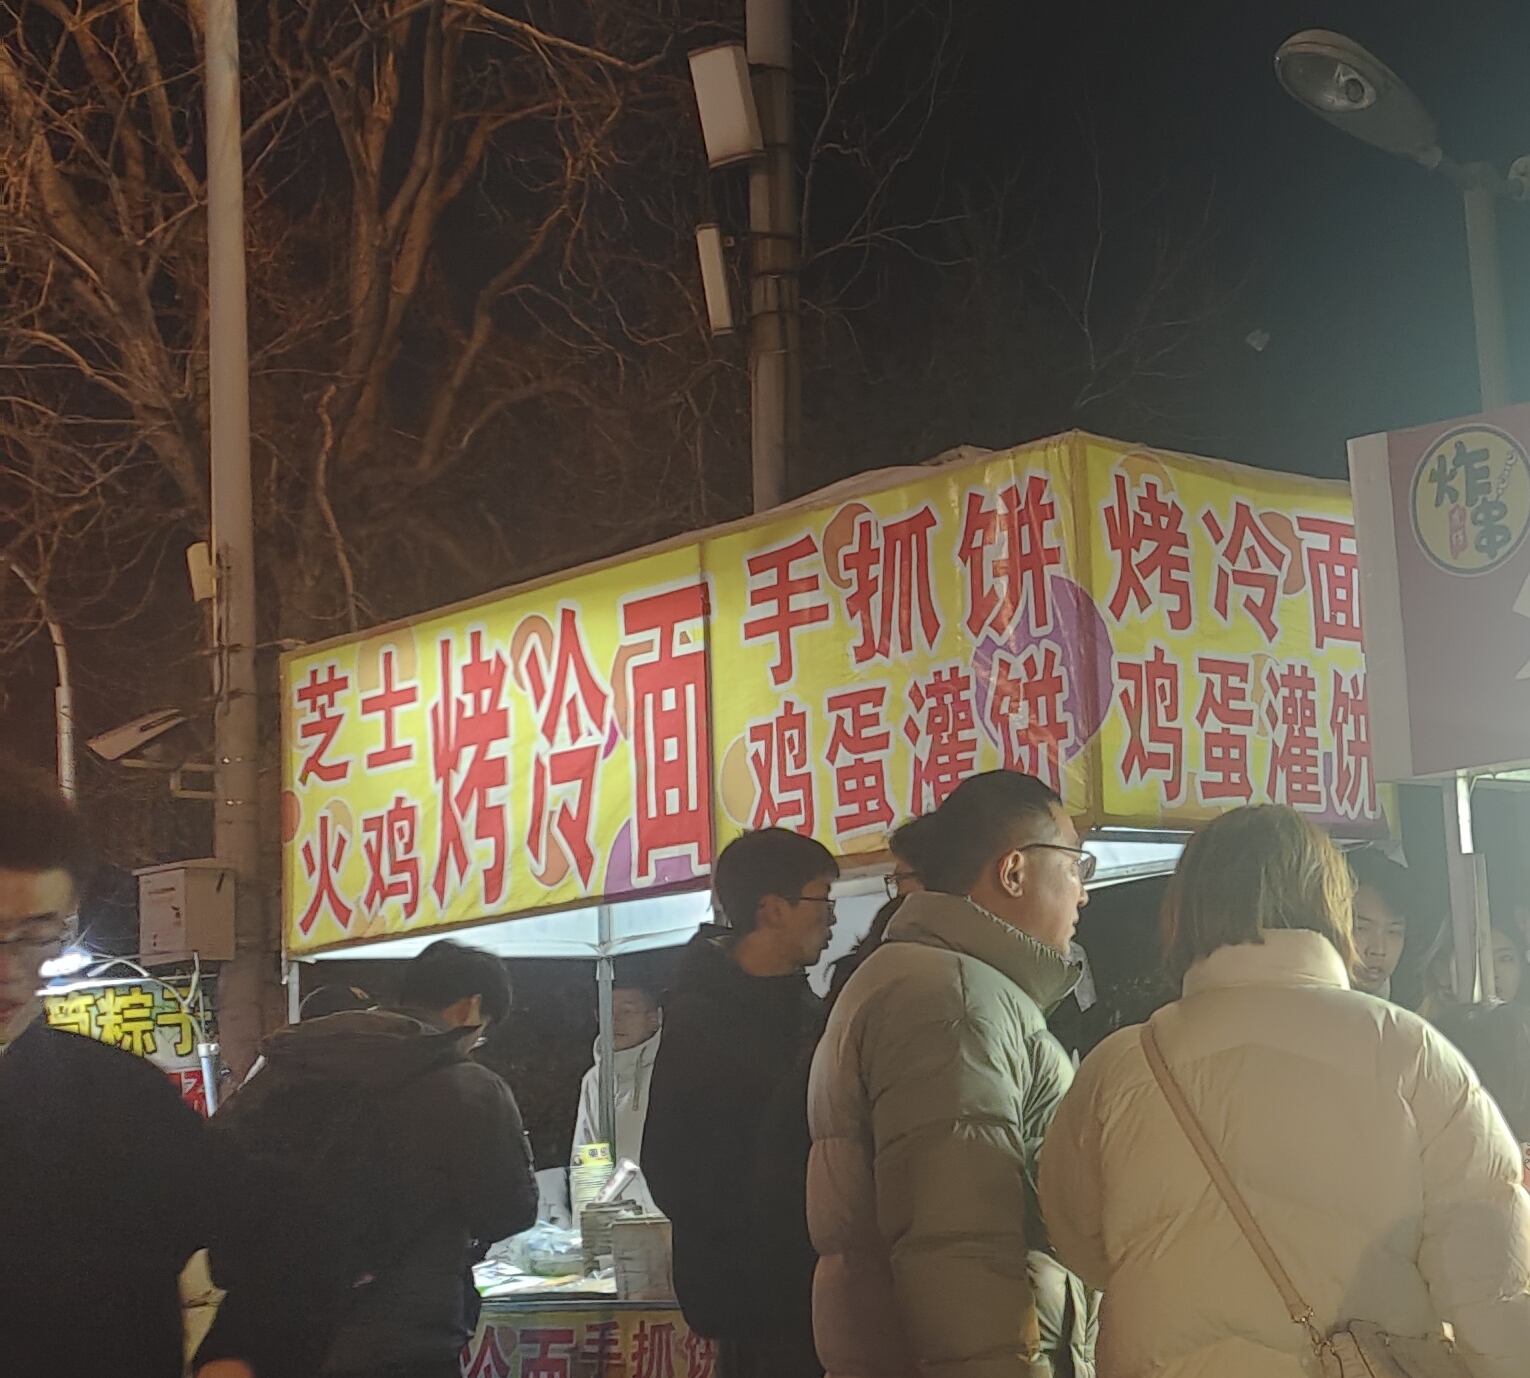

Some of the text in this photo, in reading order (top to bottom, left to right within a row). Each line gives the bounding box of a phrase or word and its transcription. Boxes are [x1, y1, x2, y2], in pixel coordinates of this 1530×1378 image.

[744, 474, 1061, 685] 手抓饼
[1103, 474, 1364, 652] 烤冷面
[1428, 440, 1512, 560] 炸串
